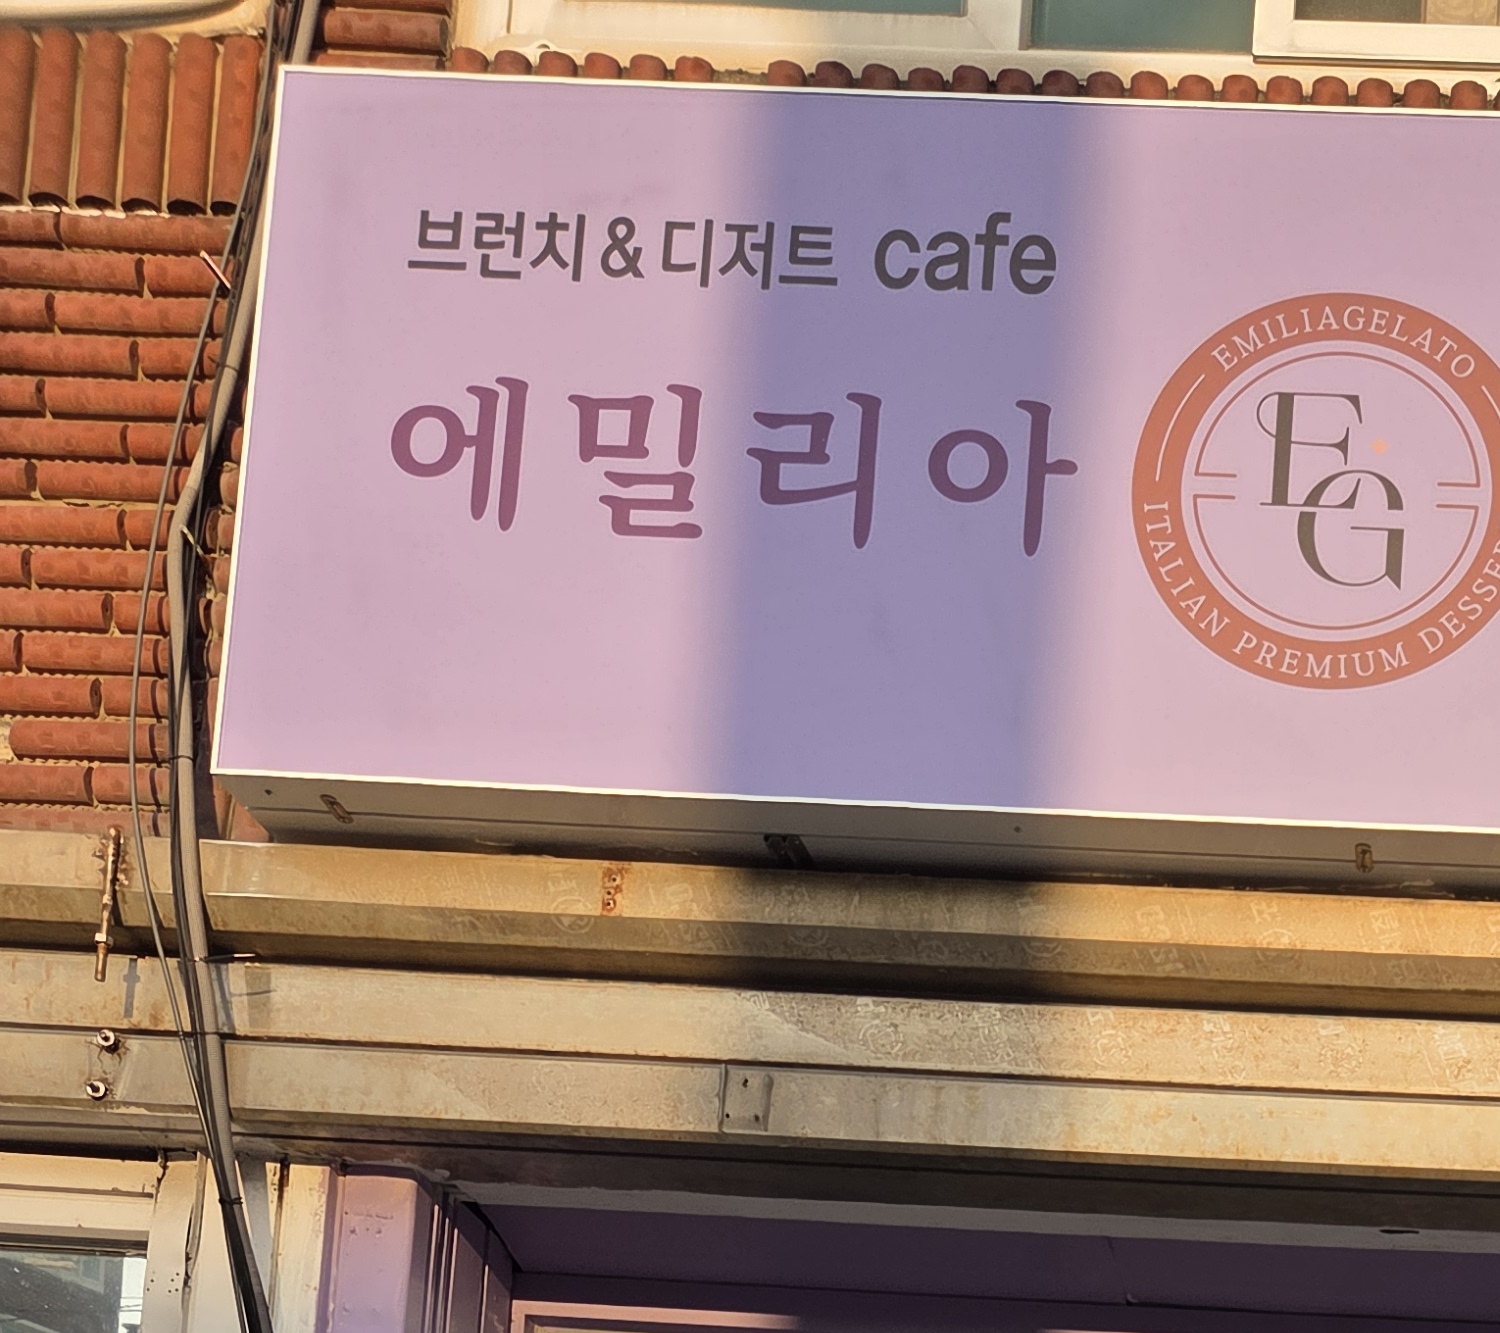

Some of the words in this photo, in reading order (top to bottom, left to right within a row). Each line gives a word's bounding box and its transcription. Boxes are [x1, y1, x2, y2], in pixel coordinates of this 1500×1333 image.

[406, 209, 840, 291] 브런치&디저트
[874, 212, 1058, 295] cafe
[1211, 304, 1476, 380] EMILIAGELATO
[390, 375, 1079, 557] 에밀리아
[1144, 500, 1231, 638] ITALIAN
[1232, 631, 1410, 681] PREMIUM
